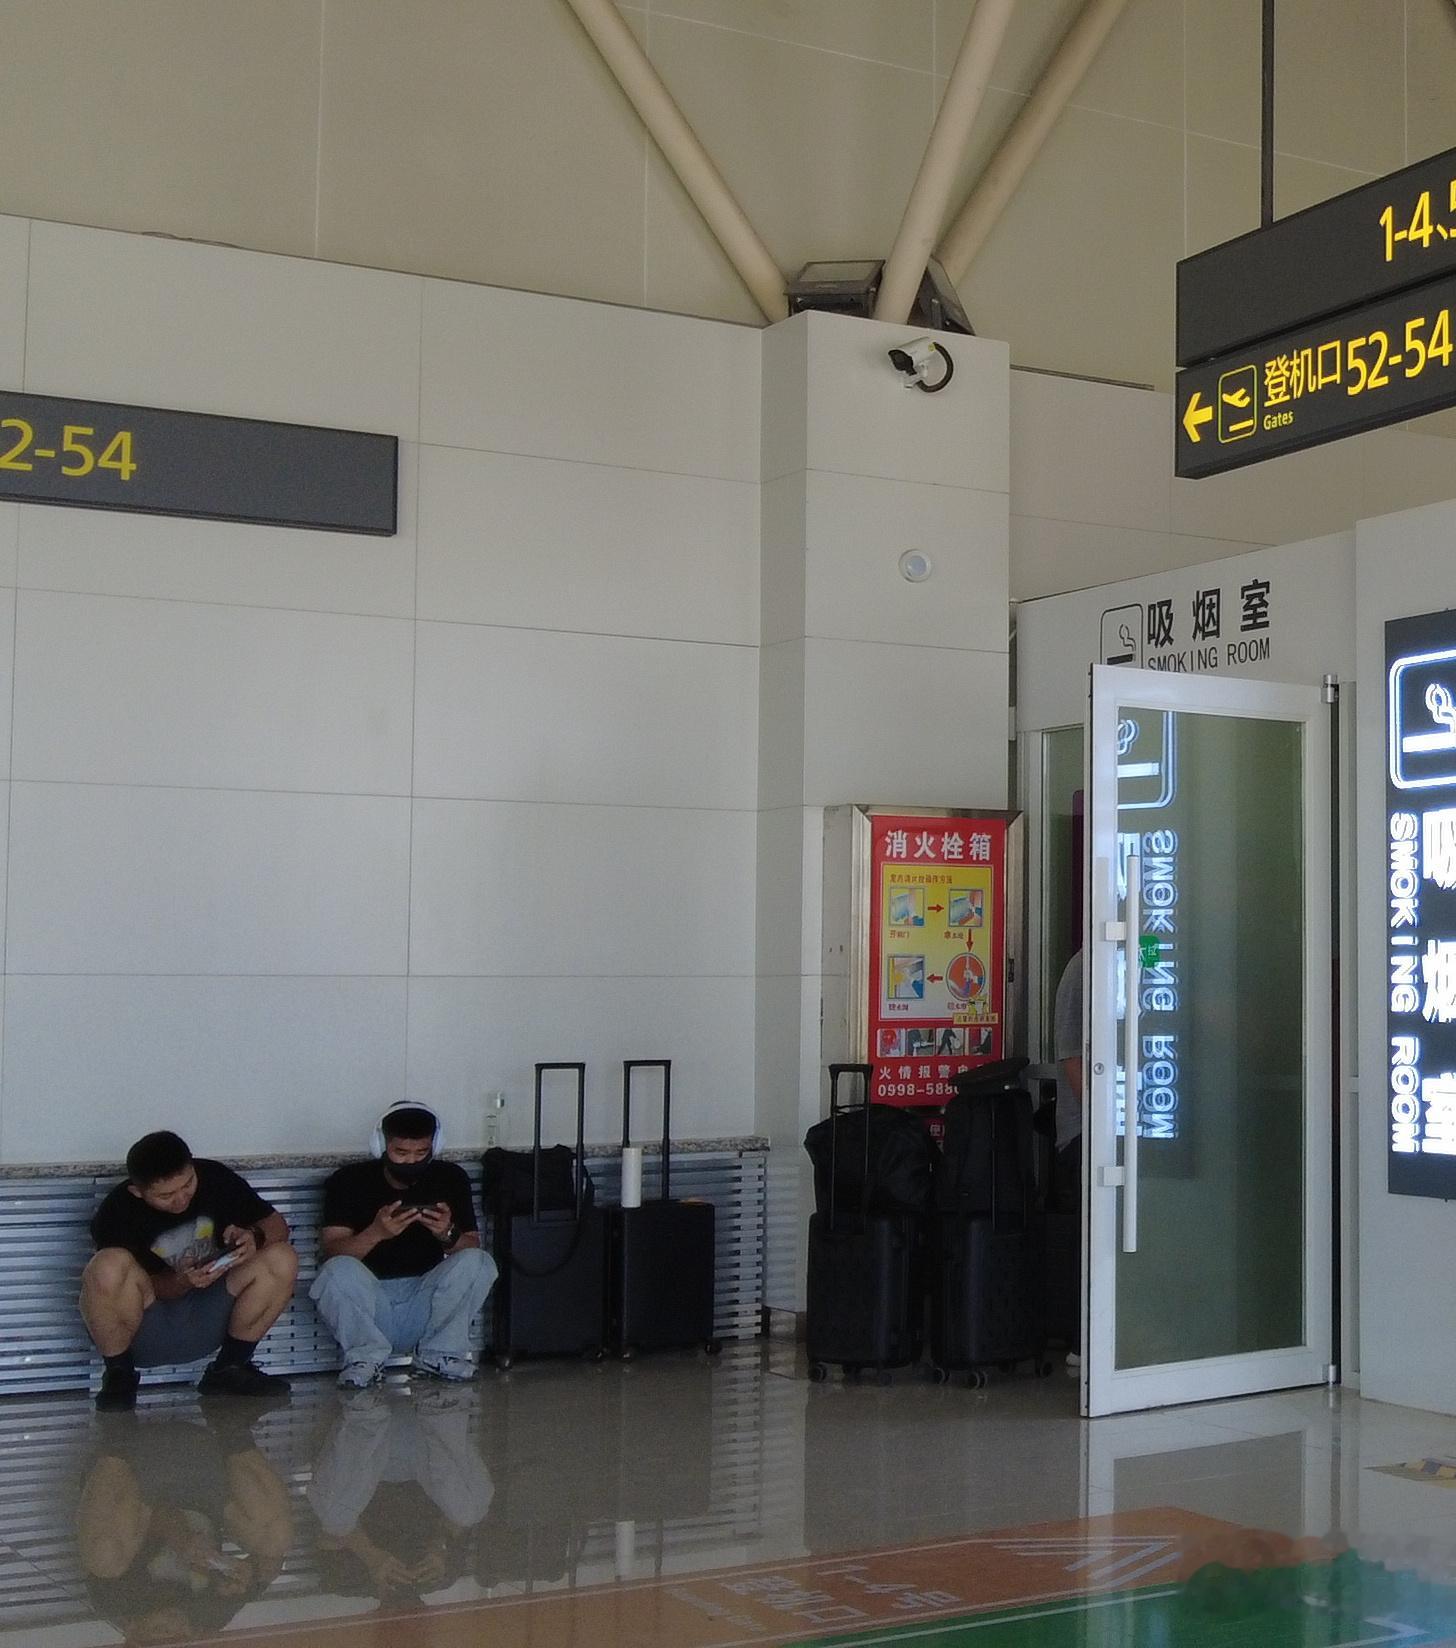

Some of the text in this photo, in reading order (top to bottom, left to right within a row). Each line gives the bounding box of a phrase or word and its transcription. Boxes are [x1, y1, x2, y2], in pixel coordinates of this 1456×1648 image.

[1263, 410, 1294, 431] Gates
[0, 418, 138, 481] 2-54
[1147, 579, 1271, 649] 吸烟室
[1148, 637, 1271, 673] SMOKING ROOM
[884, 829, 992, 861] 消火栓箱
[1390, 812, 1420, 1153] SMOKING ROOM
